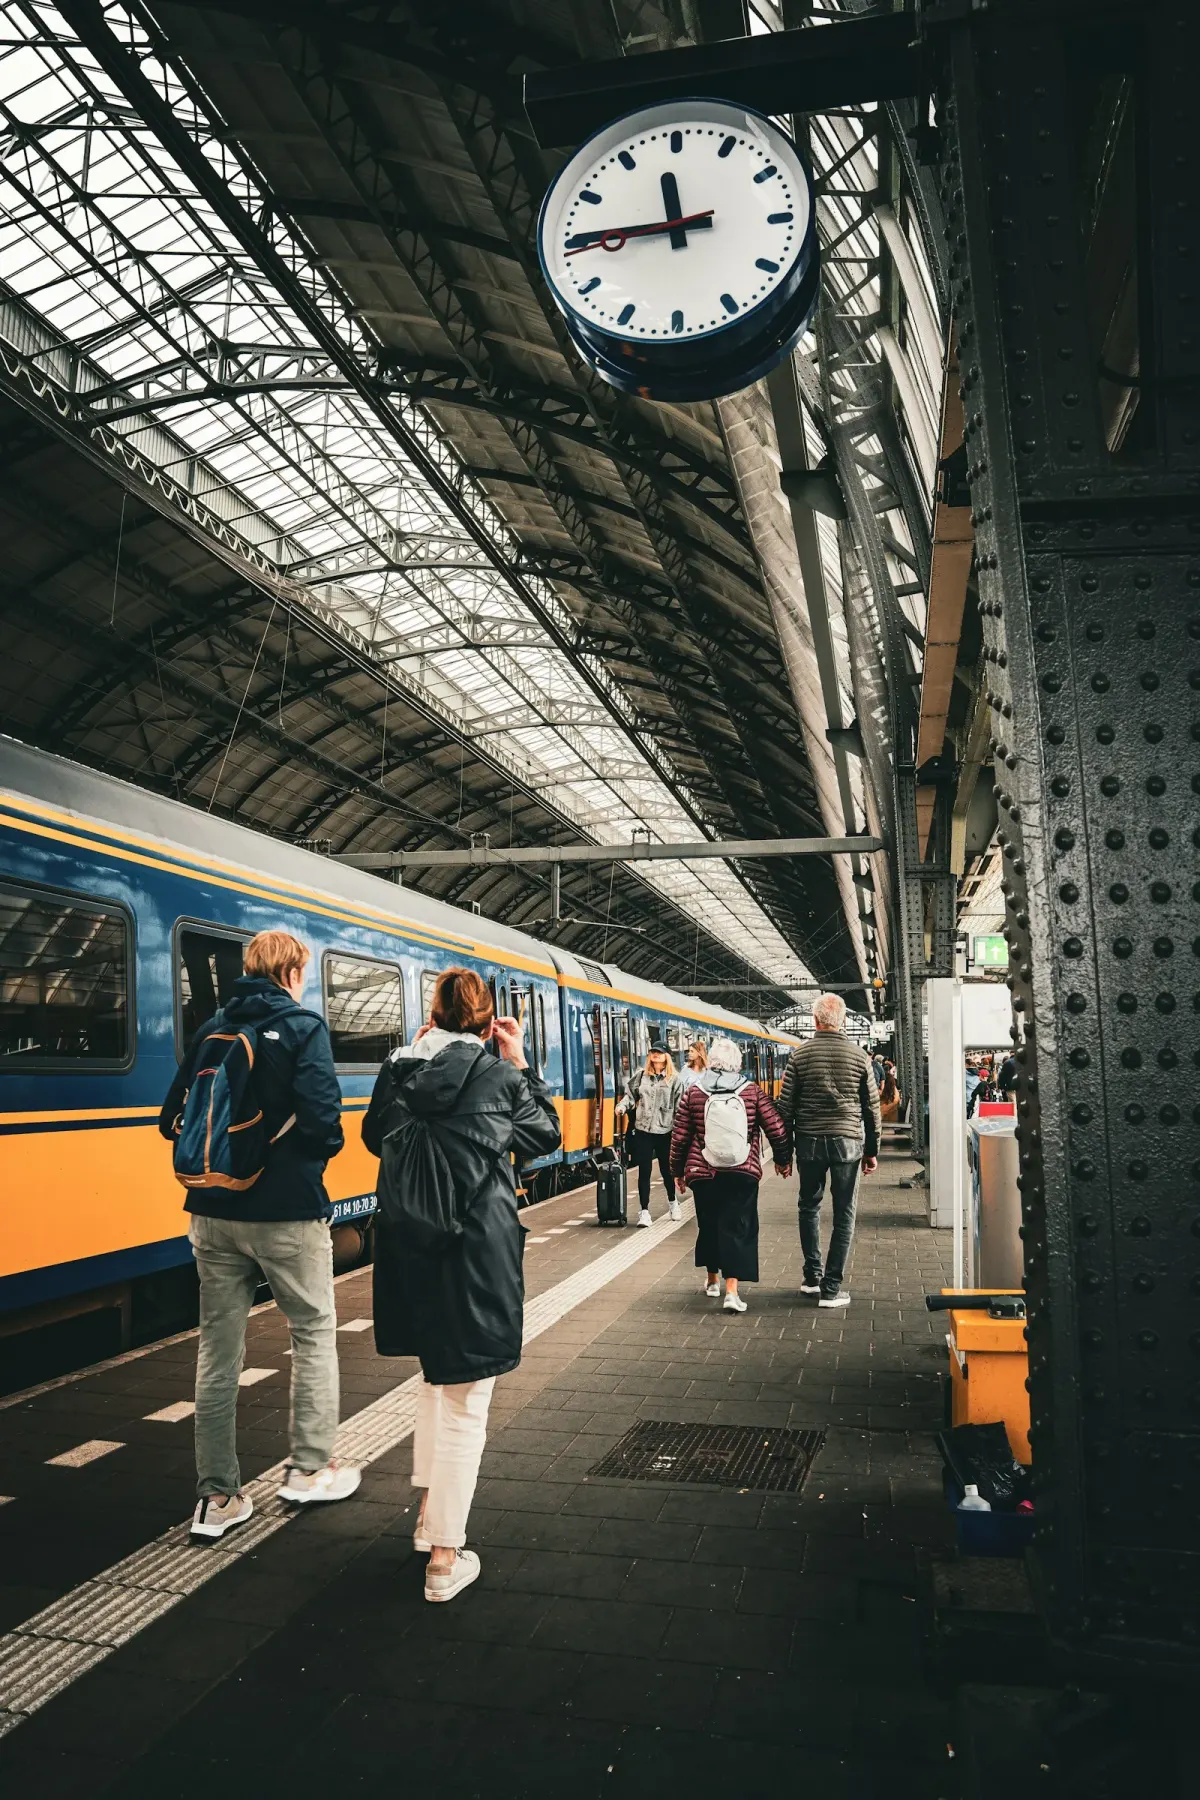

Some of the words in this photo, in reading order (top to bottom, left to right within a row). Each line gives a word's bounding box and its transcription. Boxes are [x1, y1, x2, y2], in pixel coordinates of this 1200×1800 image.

[407, 965, 416, 1004] 1
[572, 1004, 579, 1032] 2
[885, 1023, 892, 1031] G
[333, 1204, 342, 1218] 61
[343, 1201, 352, 1216] 84
[352, 1197, 369, 1213] 10-70
